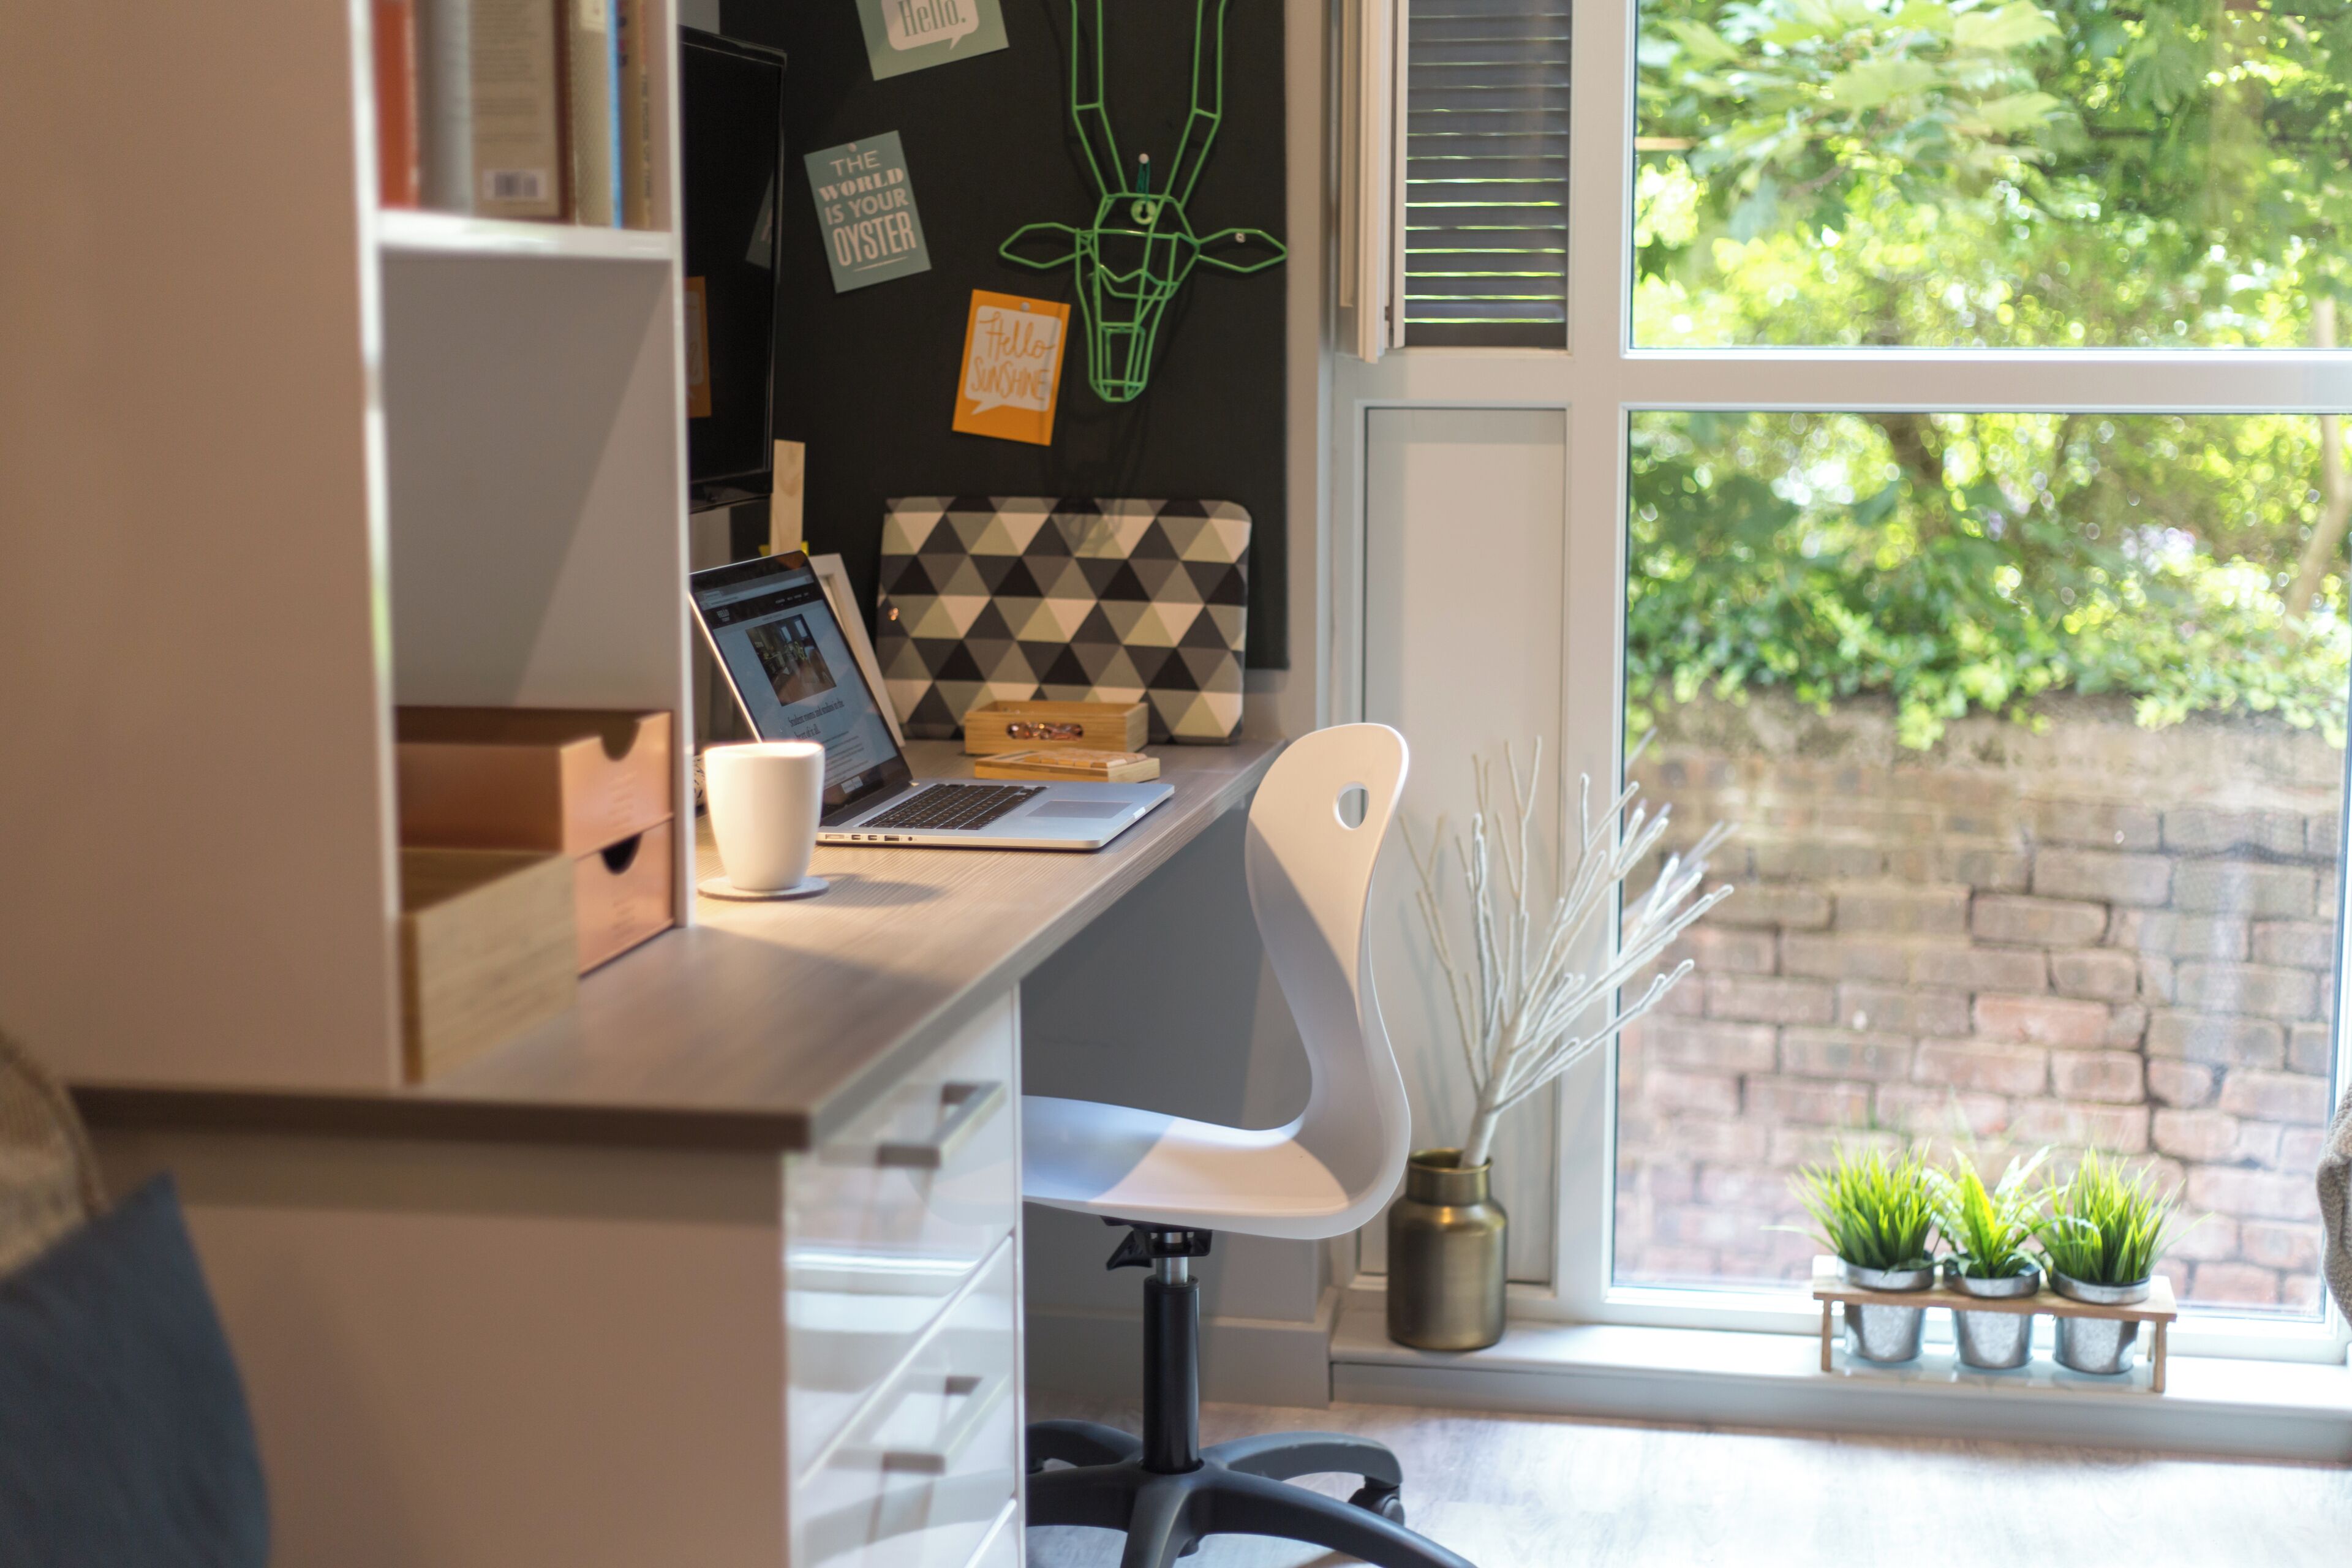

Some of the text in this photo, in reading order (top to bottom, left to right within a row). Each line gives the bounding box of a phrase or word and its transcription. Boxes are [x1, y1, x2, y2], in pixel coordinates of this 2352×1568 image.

[898, 0, 967, 37] Hello.
[829, 150, 881, 176] THE
[818, 168, 904, 202] WORLD
[824, 187, 910, 225] IS YOUR
[833, 211, 916, 266] OYSTER
[979, 311, 1055, 361] Hello
[971, 356, 1050, 401] SUNSHINE
